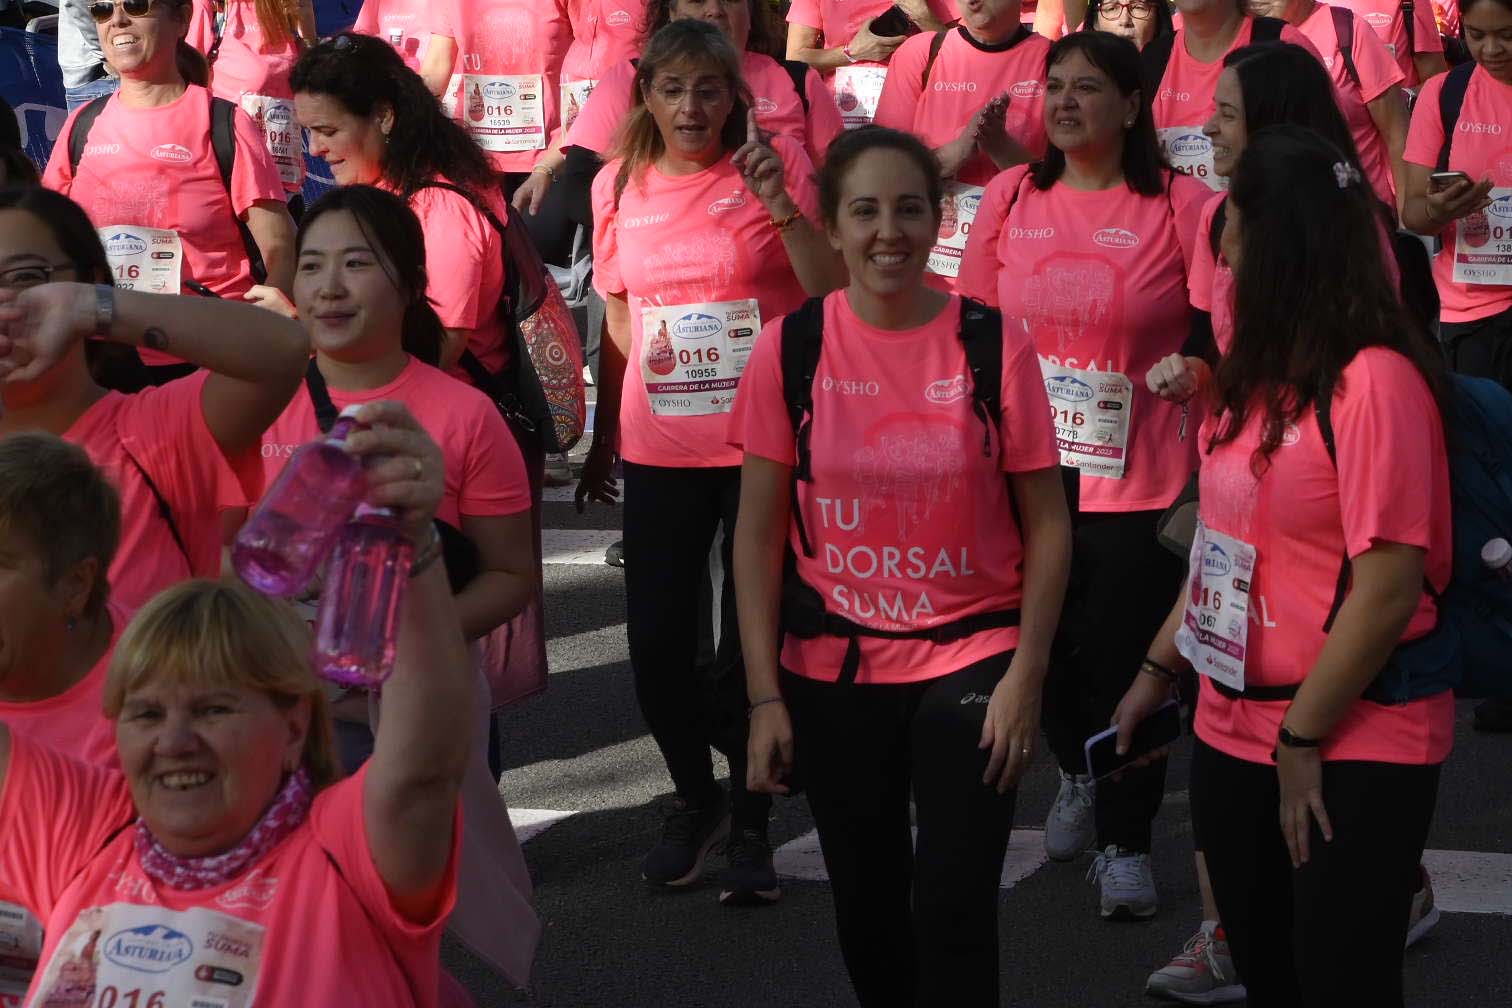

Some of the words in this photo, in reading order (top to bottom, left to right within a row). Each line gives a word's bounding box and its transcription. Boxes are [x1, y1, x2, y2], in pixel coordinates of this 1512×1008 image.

[934, 80, 977, 93] OYSHO
[487, 105, 513, 116] 016
[270, 130, 291, 143] 016
[1460, 121, 1501, 135] OYSHO
[1009, 227, 1055, 240] OYSHO
[676, 323, 719, 334] ASTURIANA
[726, 314, 750, 322] SUMA
[679, 347, 720, 365] 016
[685, 368, 717, 379] 10955
[823, 376, 879, 397] OYSHO
[816, 497, 860, 531] TU
[826, 544, 975, 579] DORSAL
[832, 584, 935, 620] SUMA
[205, 938, 250, 959] SUMA
[100, 985, 166, 1008] 016
